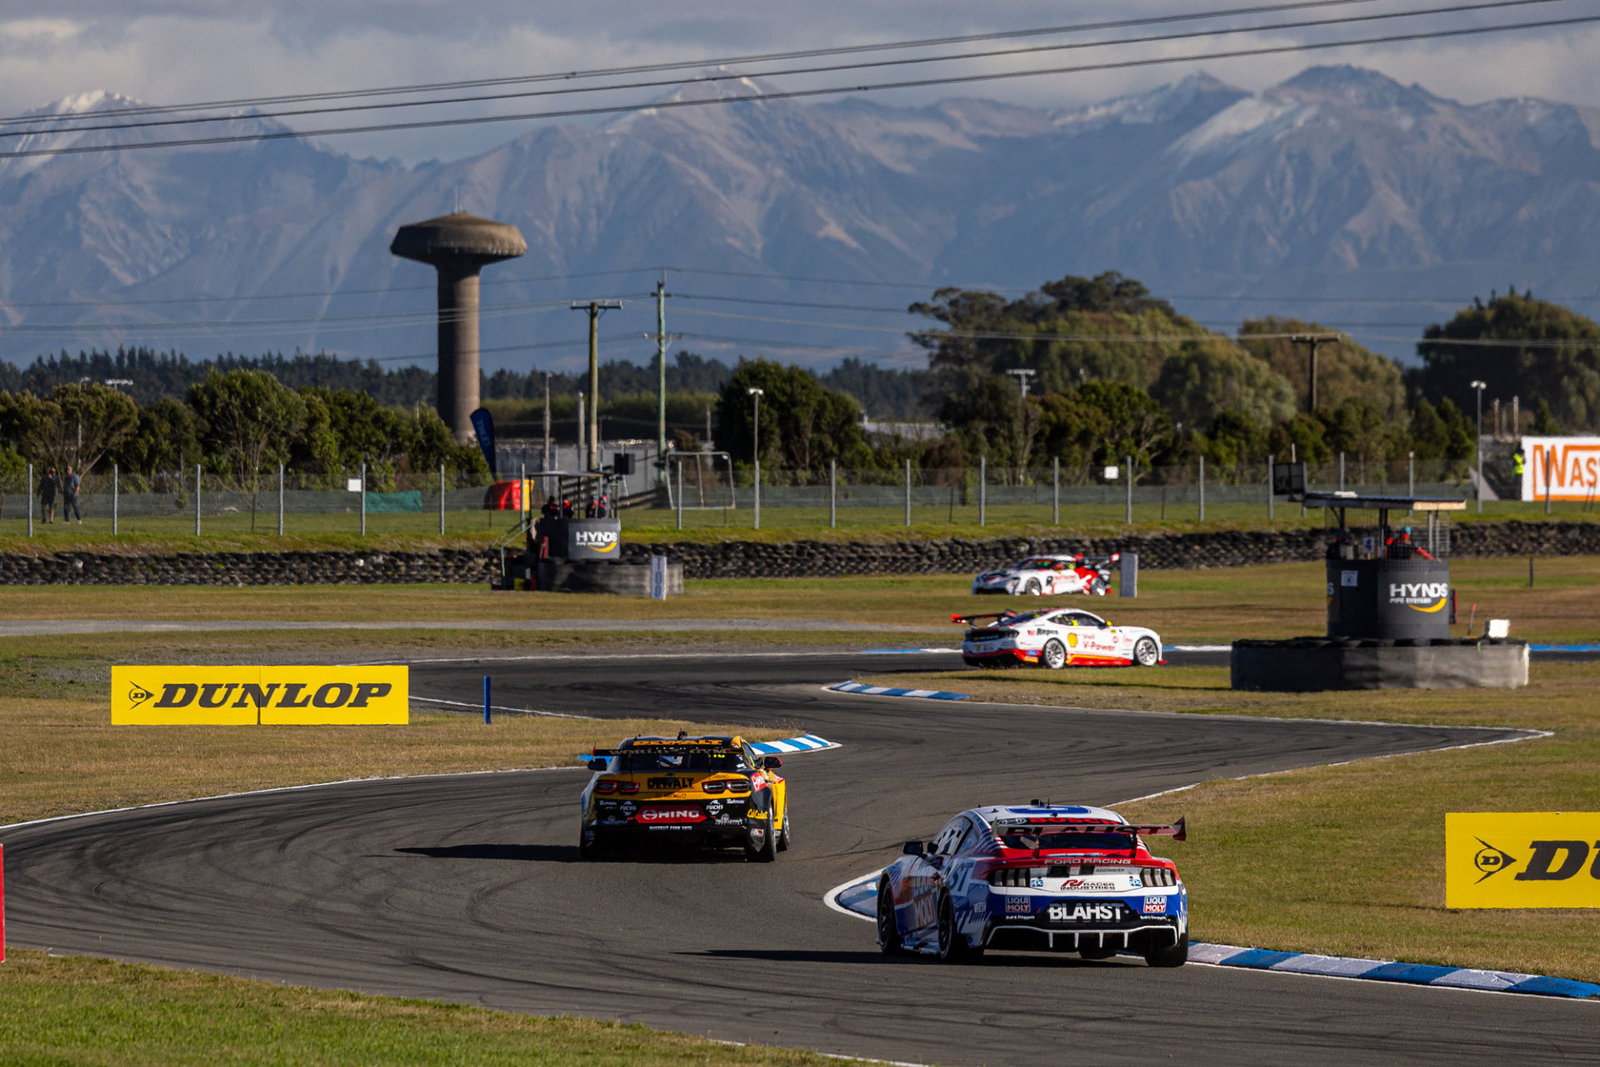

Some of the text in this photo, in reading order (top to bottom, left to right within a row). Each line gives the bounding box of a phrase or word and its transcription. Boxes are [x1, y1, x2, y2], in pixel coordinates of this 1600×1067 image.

[1536, 444, 1600, 488] WAS
[576, 531, 617, 542] HYNDS
[1389, 583, 1448, 598] HYNDS
[1083, 640, 1116, 651] V-Power
[153, 683, 392, 708] DUNLOP
[647, 777, 695, 789] DEWALT
[659, 810, 700, 818] HINO
[1049, 903, 1125, 920] BLAHST
[1145, 904, 1166, 912] MOLY
